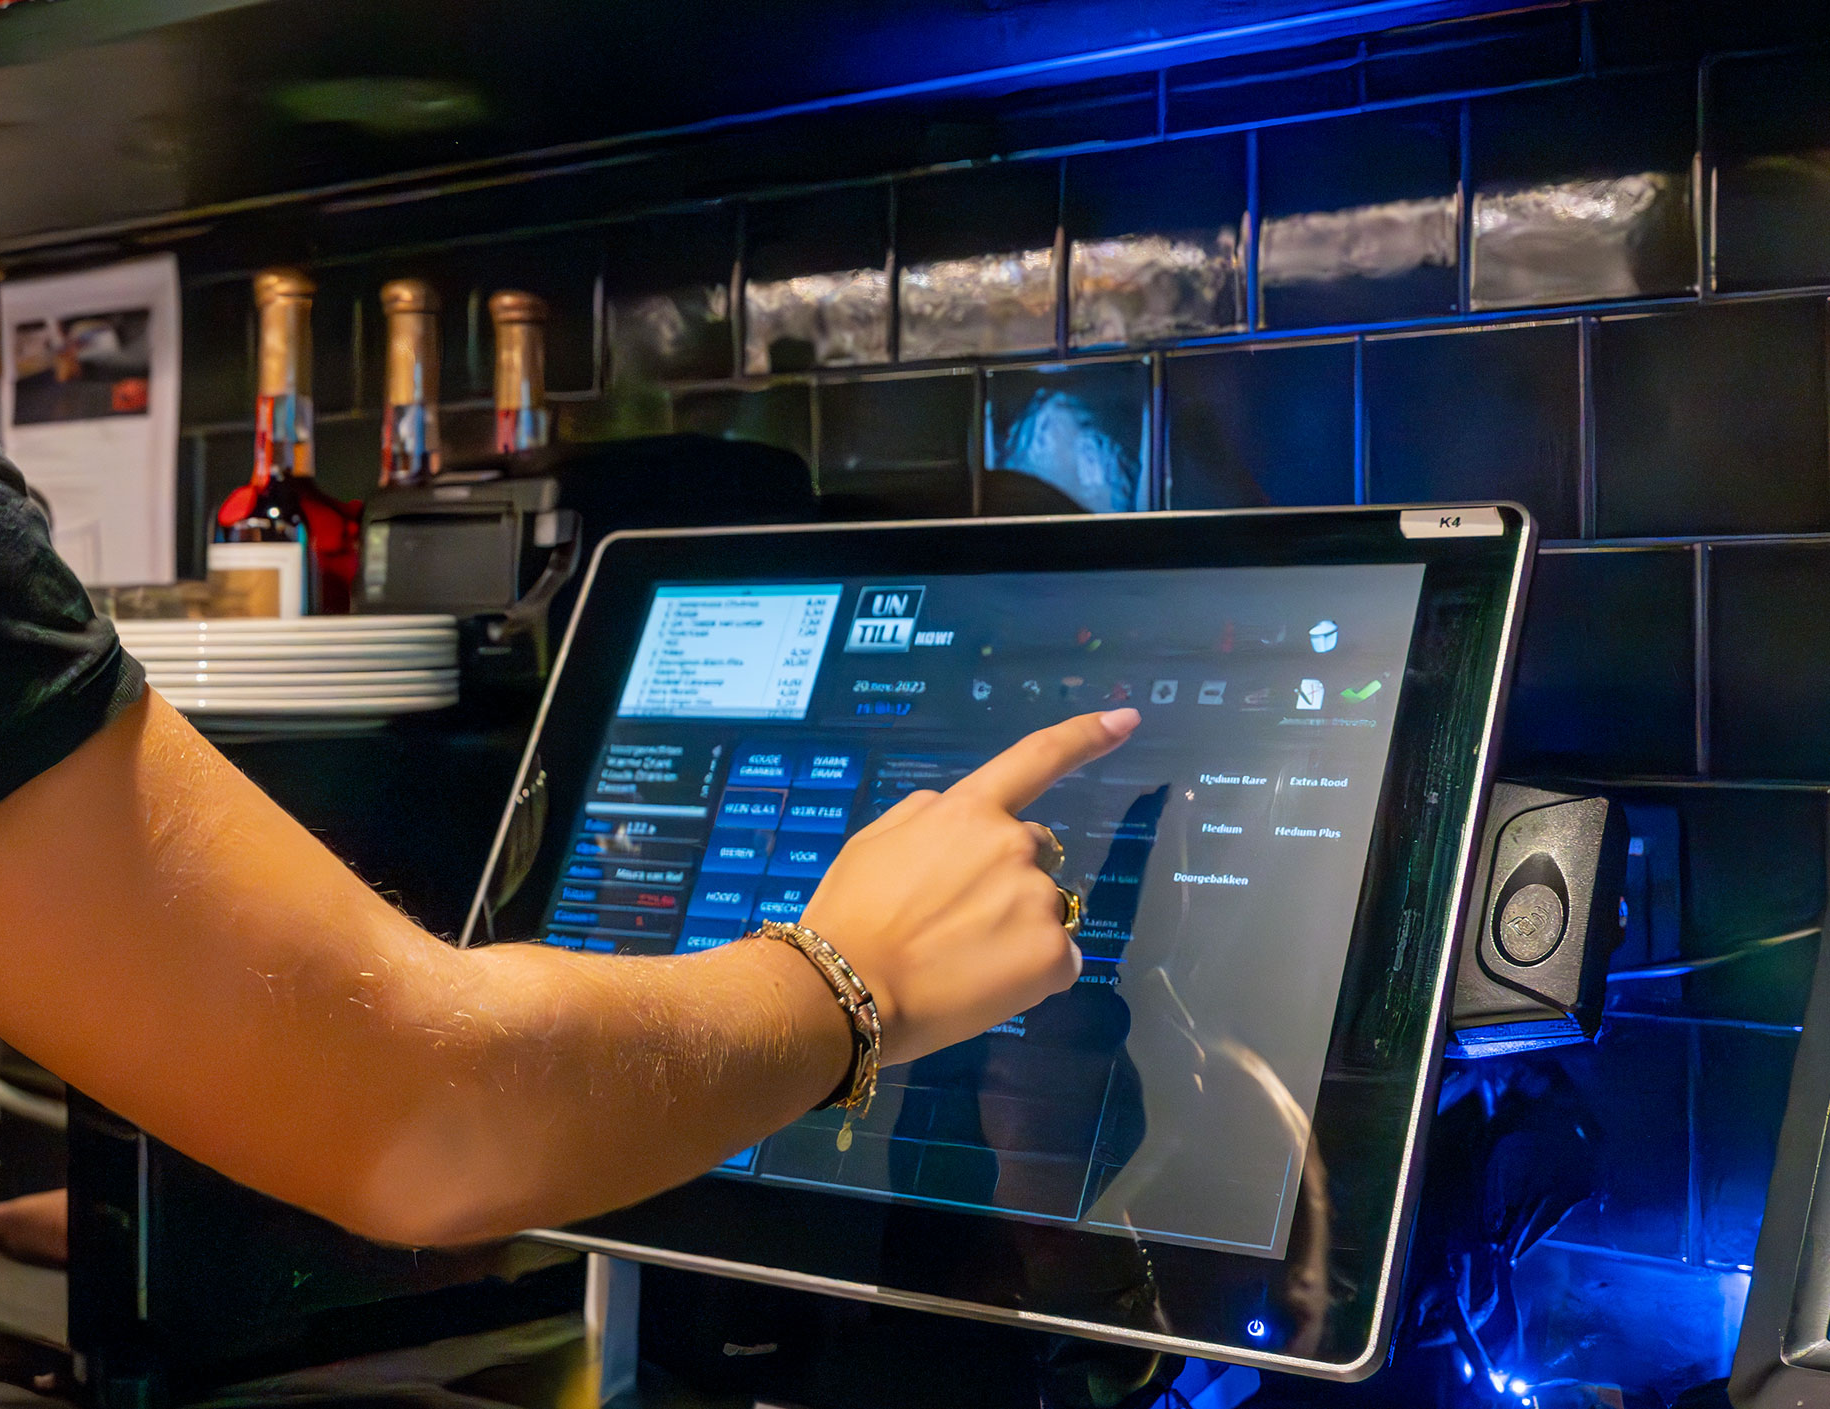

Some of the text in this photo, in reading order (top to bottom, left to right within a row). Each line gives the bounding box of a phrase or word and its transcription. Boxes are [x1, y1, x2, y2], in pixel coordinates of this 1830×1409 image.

[1439, 516, 1461, 528] K4
[871, 593, 909, 617] UN
[858, 623, 904, 644] TILL
[1200, 774, 1268, 786] Medium Rare
[1289, 776, 1348, 788] Extra Rood
[1202, 823, 1243, 834] Medium
[1274, 826, 1341, 839] Medium Plus
[790, 850, 817, 862] VOOR
[1173, 872, 1249, 886] Doorgebakken
